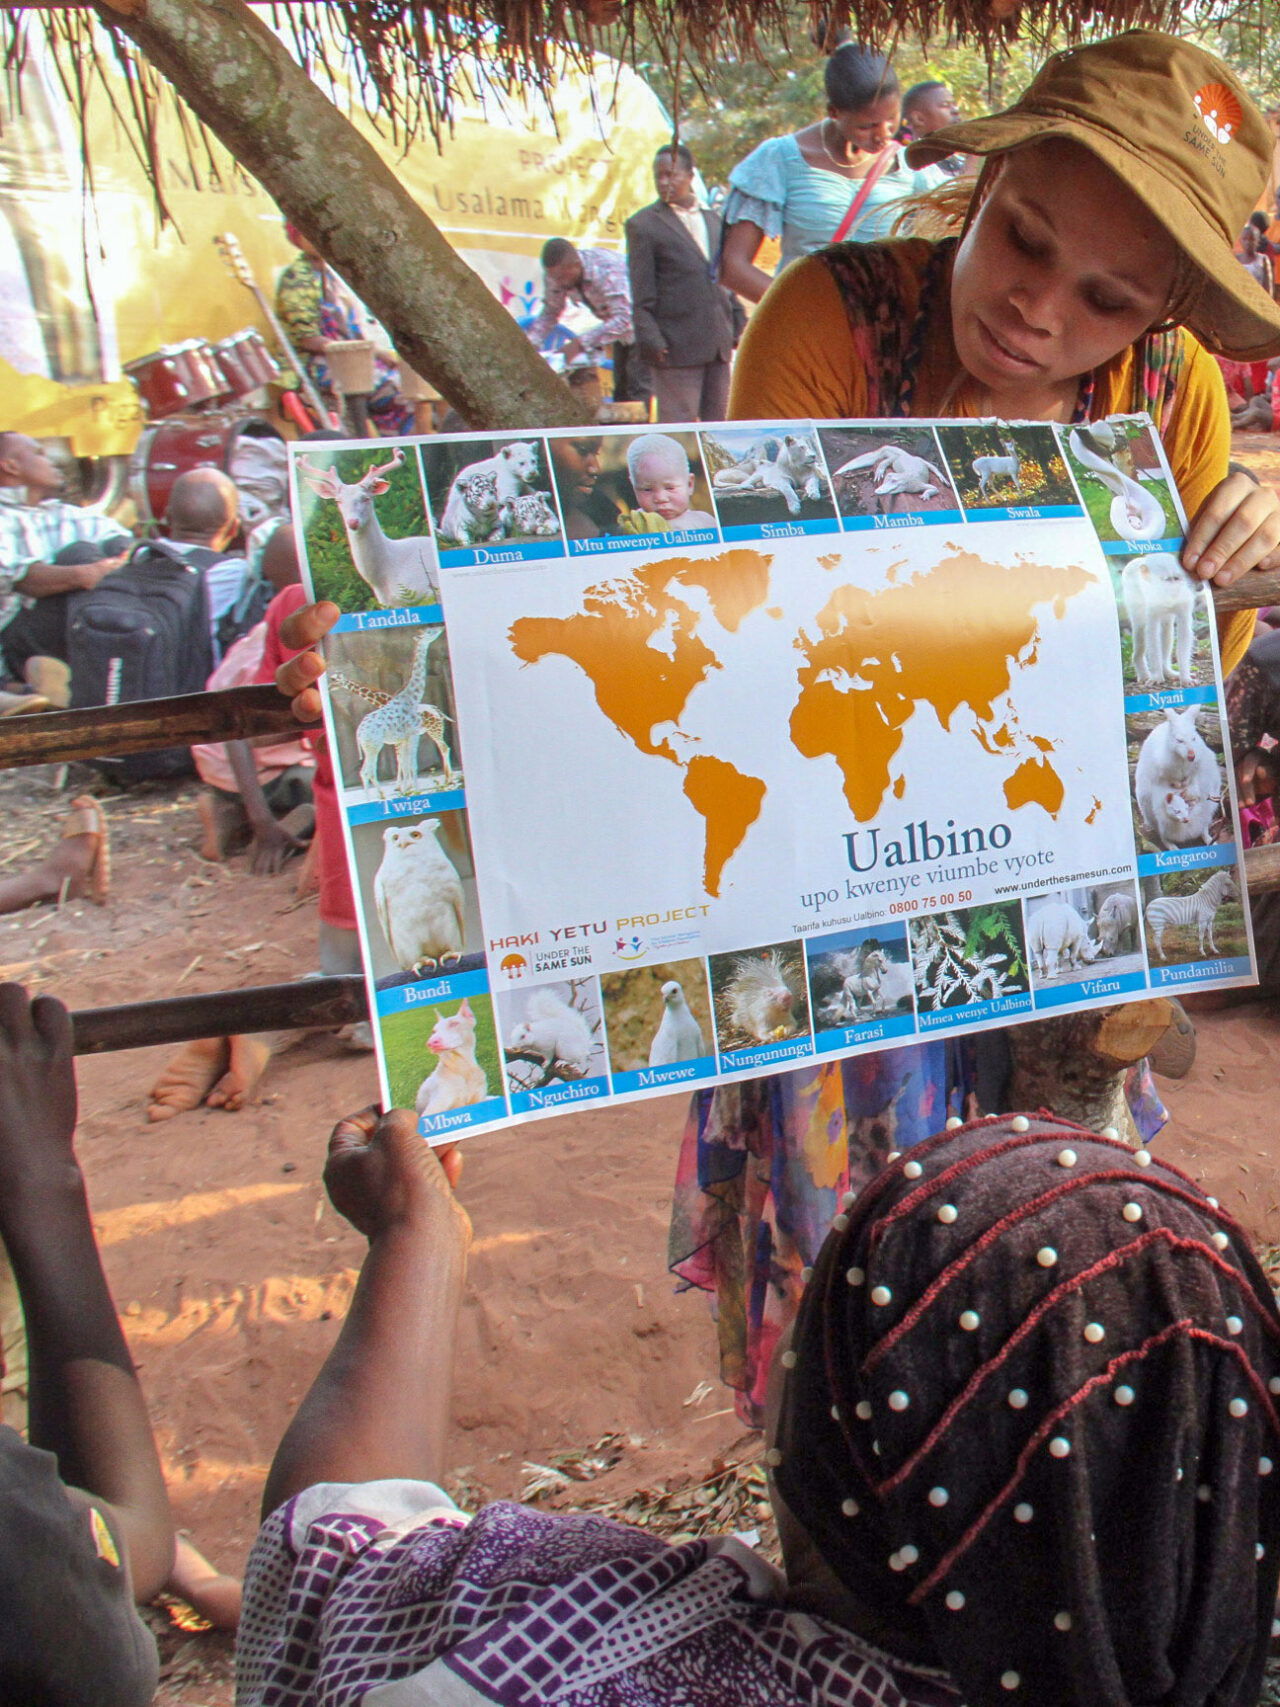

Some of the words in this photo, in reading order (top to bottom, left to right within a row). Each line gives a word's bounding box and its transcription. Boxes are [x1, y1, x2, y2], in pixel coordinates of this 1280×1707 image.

[1184, 131, 1210, 159] SAME
[433, 183, 545, 219] Usalama
[872, 513, 925, 529] Mamba
[1007, 506, 1041, 519] Swala
[574, 539, 604, 553] Mtu
[607, 536, 660, 549] mwenye
[662, 530, 714, 545] Ualbino
[761, 523, 805, 538] Simba
[472, 548, 524, 565] Duma
[1125, 539, 1163, 554] Nyoka
[352, 608, 421, 629] Tandala
[1149, 690, 1185, 709] Nyani
[379, 796, 431, 815] Twiga
[842, 818, 1012, 873] Ualbino
[1155, 849, 1217, 868] Kangaroo
[800, 887, 840, 913] upo
[846, 870, 921, 900] kwenye
[926, 856, 999, 884] viumbe
[1004, 849, 1055, 876] vyote
[994, 863, 1132, 895] www.underthesamesun.com
[822, 915, 852, 928] kuhusu
[889, 898, 918, 915] 0800
[922, 896, 937, 909] 75
[940, 893, 954, 906] 00
[958, 889, 973, 903] 50
[489, 931, 540, 952] HAKI
[549, 920, 607, 942] YETU
[616, 904, 711, 932] PROJECT
[535, 957, 568, 972] SAME
[570, 954, 592, 967] SUN
[536, 949, 570, 962] UNDER
[573, 945, 590, 957] THE
[1161, 961, 1235, 983] Pundamilia
[403, 980, 452, 1003] Bundi
[1081, 979, 1120, 996] Vifaru
[919, 1013, 953, 1028] Mmea
[956, 1007, 988, 1021] wenye
[991, 997, 1032, 1013] Ualbino
[845, 1023, 884, 1045] Farasi
[722, 1040, 813, 1070] Nungunungu
[638, 1065, 695, 1087] Mwewe
[528, 1083, 599, 1108] Nguchiro
[423, 1111, 472, 1134] Mbwa
